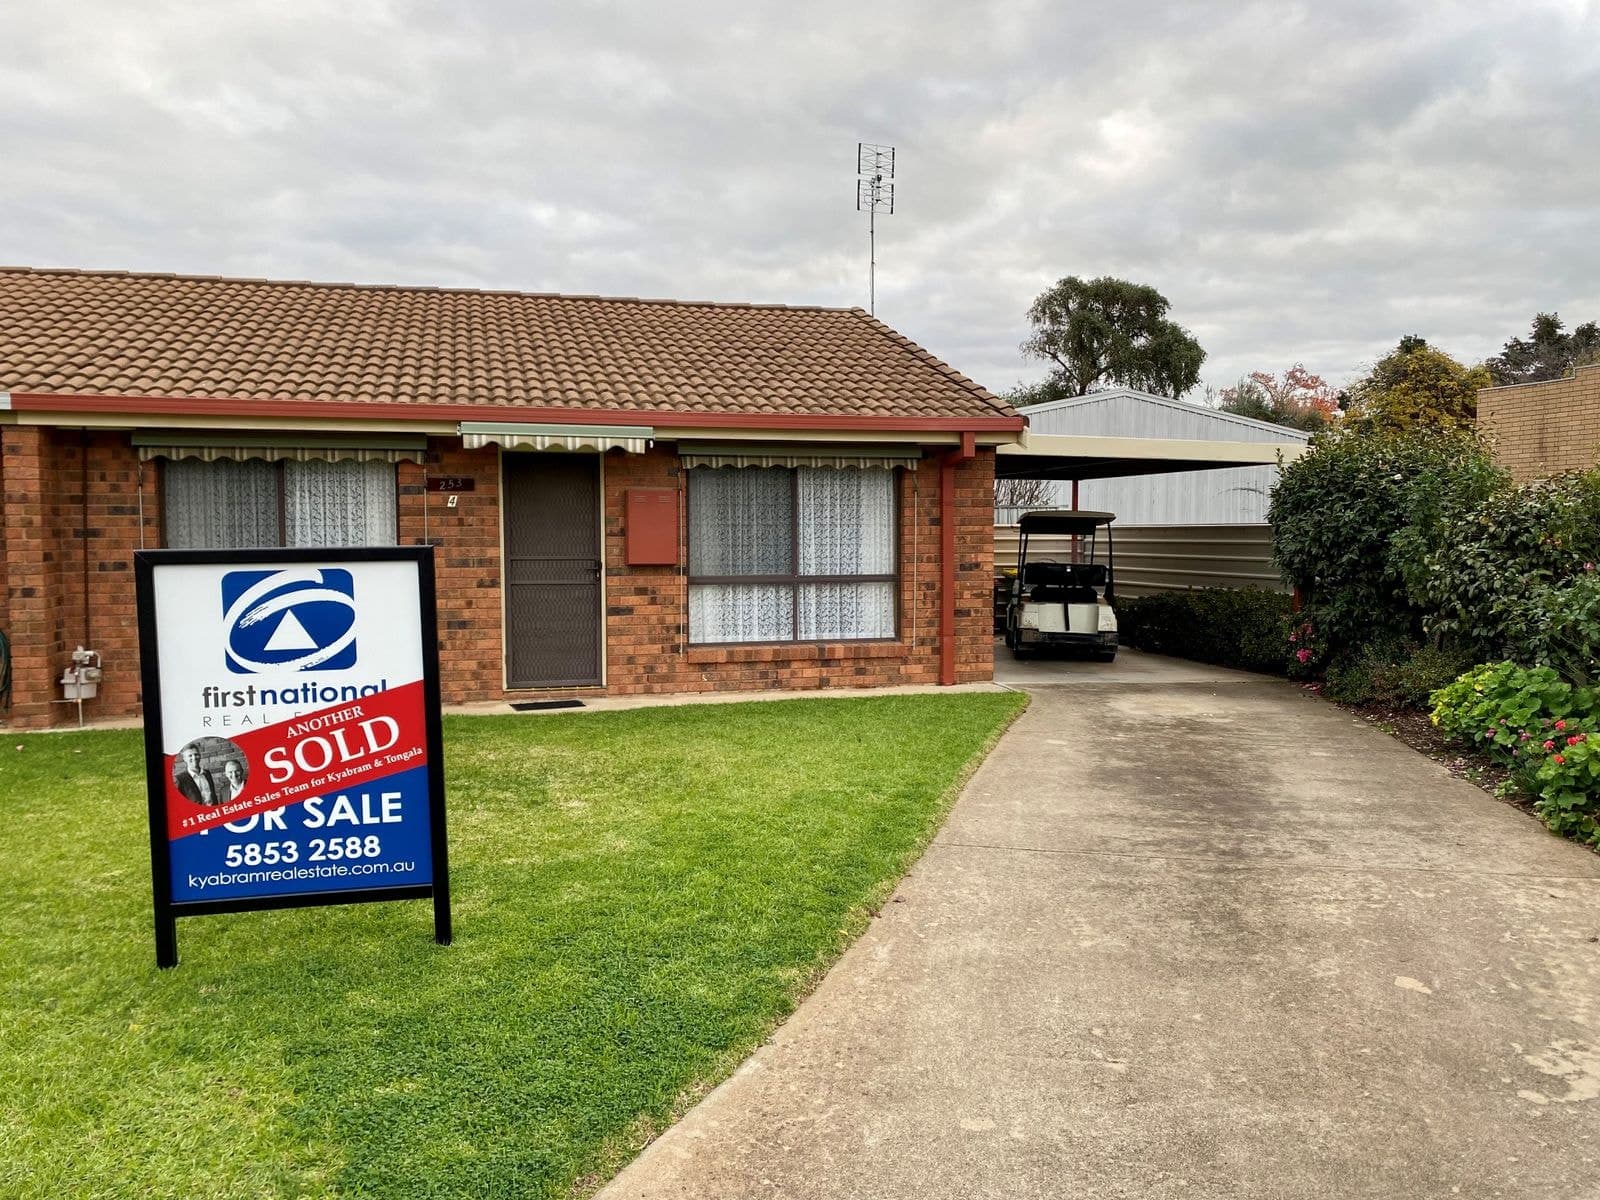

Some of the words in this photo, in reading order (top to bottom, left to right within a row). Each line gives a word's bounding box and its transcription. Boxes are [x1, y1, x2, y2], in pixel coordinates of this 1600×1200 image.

[203, 713, 270, 727] REAL
[286, 706, 364, 738] ANOTHER
[264, 716, 400, 783] SOLD
[182, 817, 195, 828] #1
[197, 809, 221, 823] Real
[222, 800, 253, 815] Estate
[254, 790, 281, 805] Sales
[281, 782, 310, 796] Team
[311, 777, 326, 788] for
[326, 763, 372, 783] Kyabram
[374, 758, 383, 768] &
[384, 747, 423, 764] Tongala
[302, 792, 403, 829] SALE
[225, 840, 299, 868] 5853
[308, 835, 381, 862] 2588
[188, 861, 415, 890] kyabramrealestate.com.au
